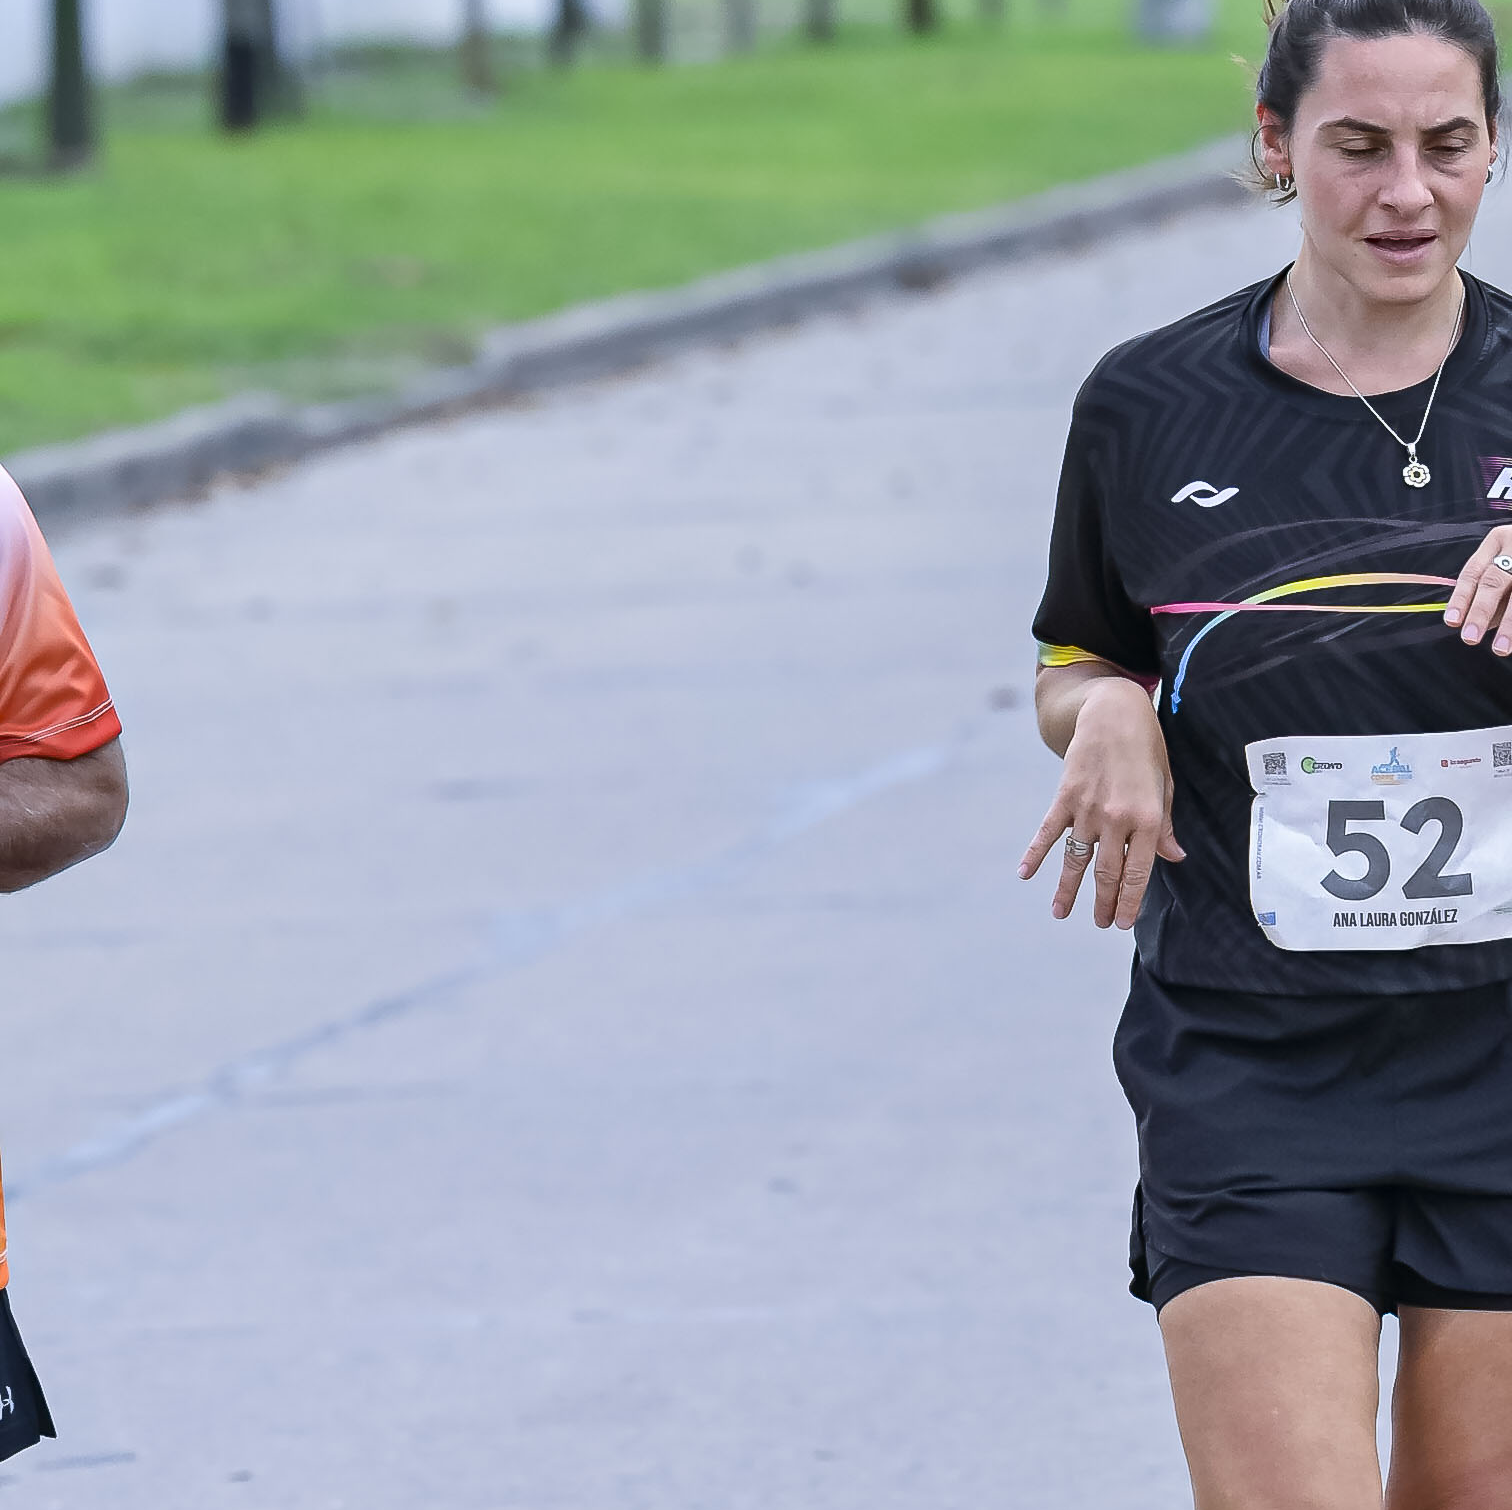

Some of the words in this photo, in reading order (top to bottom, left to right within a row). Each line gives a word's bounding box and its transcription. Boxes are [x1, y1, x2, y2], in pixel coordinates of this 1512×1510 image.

[1320, 796, 1474, 901] 52
[1333, 912, 1357, 927] ANA
[1360, 912, 1397, 927] LAURA
[1400, 907, 1458, 927] GONZÁLEZ
